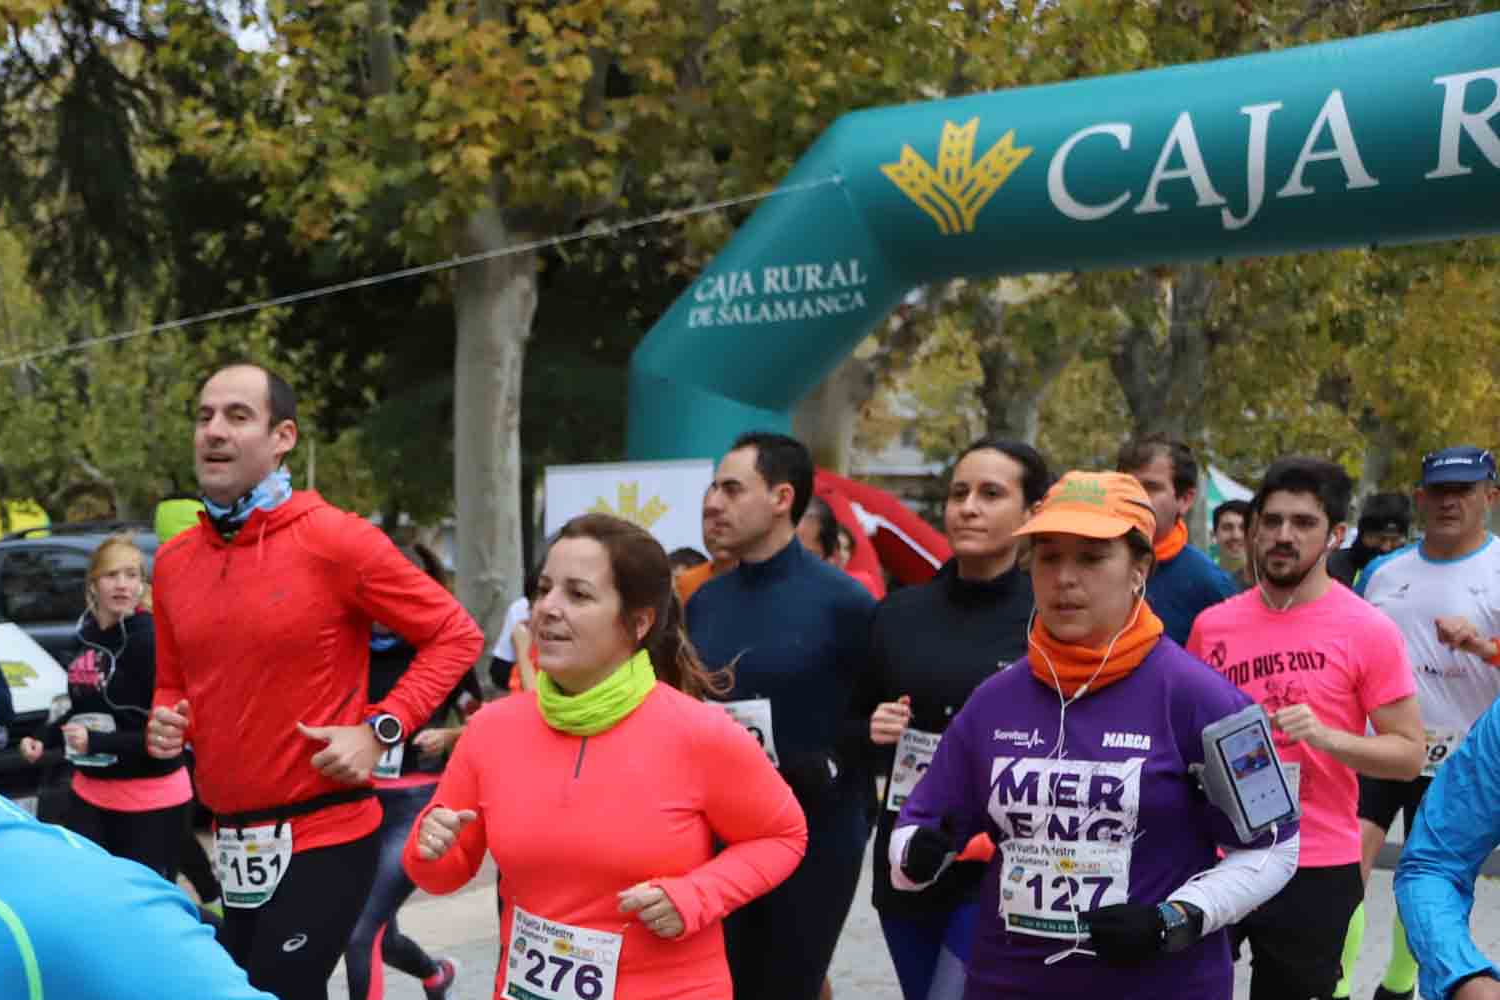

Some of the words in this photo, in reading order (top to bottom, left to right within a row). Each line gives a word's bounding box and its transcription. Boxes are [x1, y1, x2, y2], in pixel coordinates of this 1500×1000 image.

[1046, 88, 1380, 230] CAJA
[1424, 66, 1500, 180] R
[694, 271, 756, 304] CAJA
[763, 259, 869, 294] RURAL
[688, 307, 714, 328] DE
[716, 291, 867, 326] SALAMANCA
[1253, 653, 1285, 679] RUS
[1287, 652, 1327, 671] 2017
[1102, 732, 1151, 750] MARCA
[997, 771, 1125, 812] MER
[231, 853, 282, 887] 151
[1026, 874, 1114, 913] 127
[525, 948, 604, 1000] 276
